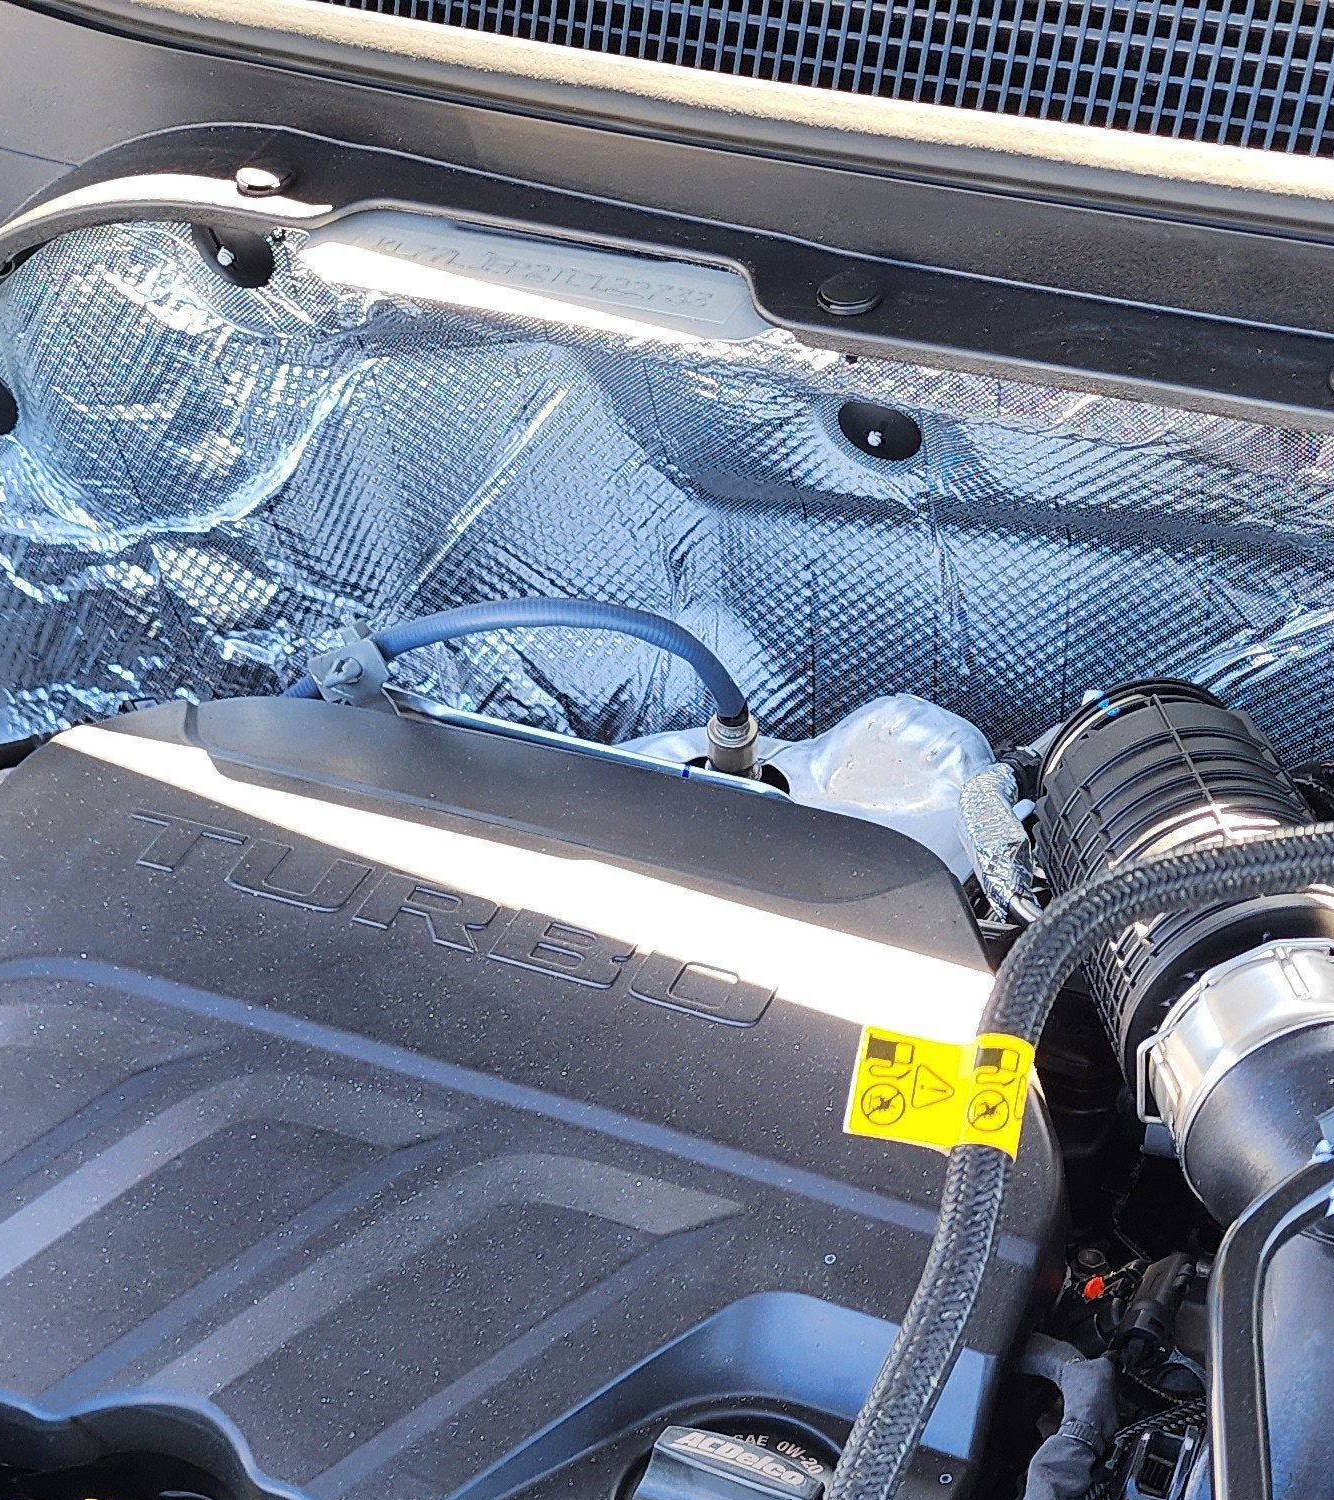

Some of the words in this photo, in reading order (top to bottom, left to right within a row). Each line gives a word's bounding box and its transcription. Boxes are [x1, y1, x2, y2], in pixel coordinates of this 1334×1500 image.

[130, 811, 778, 1028] TURBO
[670, 1431, 806, 1486] ACDelco
[776, 1441, 825, 1476] 0W-20
